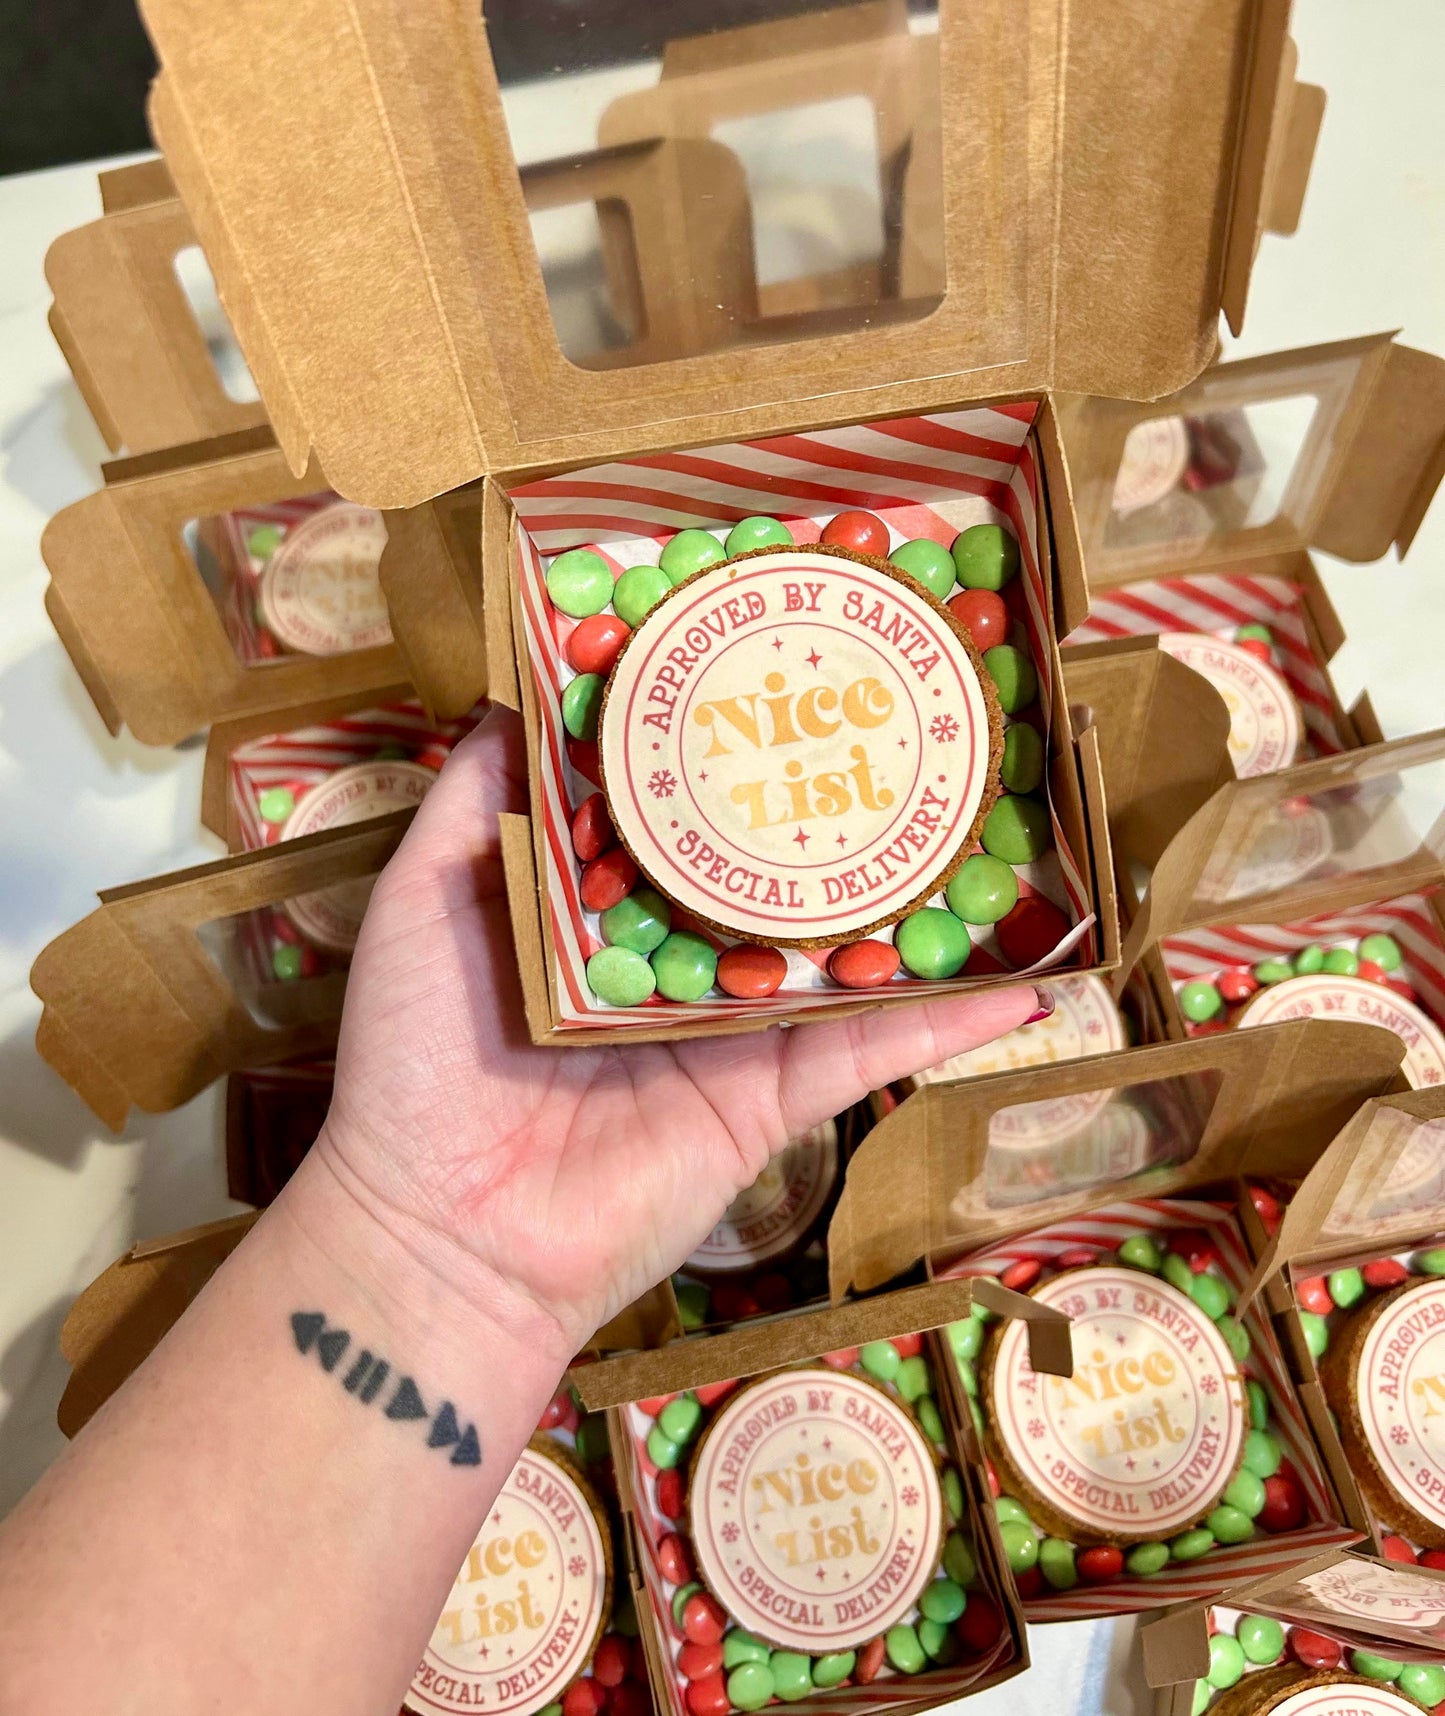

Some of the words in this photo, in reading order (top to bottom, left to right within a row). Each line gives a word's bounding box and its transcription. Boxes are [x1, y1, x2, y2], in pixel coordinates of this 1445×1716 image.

[642, 591, 766, 735] APPROVED
[783, 583, 826, 612] BY
[842, 590, 942, 681] SANTA
[693, 671, 895, 759] Nice
[730, 744, 895, 831] List
[676, 829, 804, 908] SPECIAL
[821, 785, 951, 906] DELIVERY
[1320, 993, 1346, 1011] BY
[1357, 998, 1421, 1048] SANTA
[1095, 1288, 1121, 1309] BY
[1133, 1292, 1200, 1353] SANTA
[1379, 1302, 1445, 1400] APPROVED
[1051, 1348, 1176, 1410] Nice
[718, 1394, 798, 1495] APPROVED
[807, 1390, 834, 1411] BY
[844, 1396, 907, 1461] SANTA
[1080, 1397, 1187, 1460] List
[515, 1466, 577, 1532] SANTA
[752, 1453, 879, 1514] Nice
[1050, 1458, 1140, 1514] SPECIAL
[1148, 1423, 1221, 1513] DELIVERY
[456, 1530, 548, 1586] ice
[775, 1506, 881, 1568] List
[439, 1579, 545, 1649] List
[739, 1566, 823, 1626] SPECIAL
[834, 1537, 915, 1624] DELIVERY
[415, 1660, 485, 1705] PECIAL
[496, 1608, 580, 1702] DELIVERY
